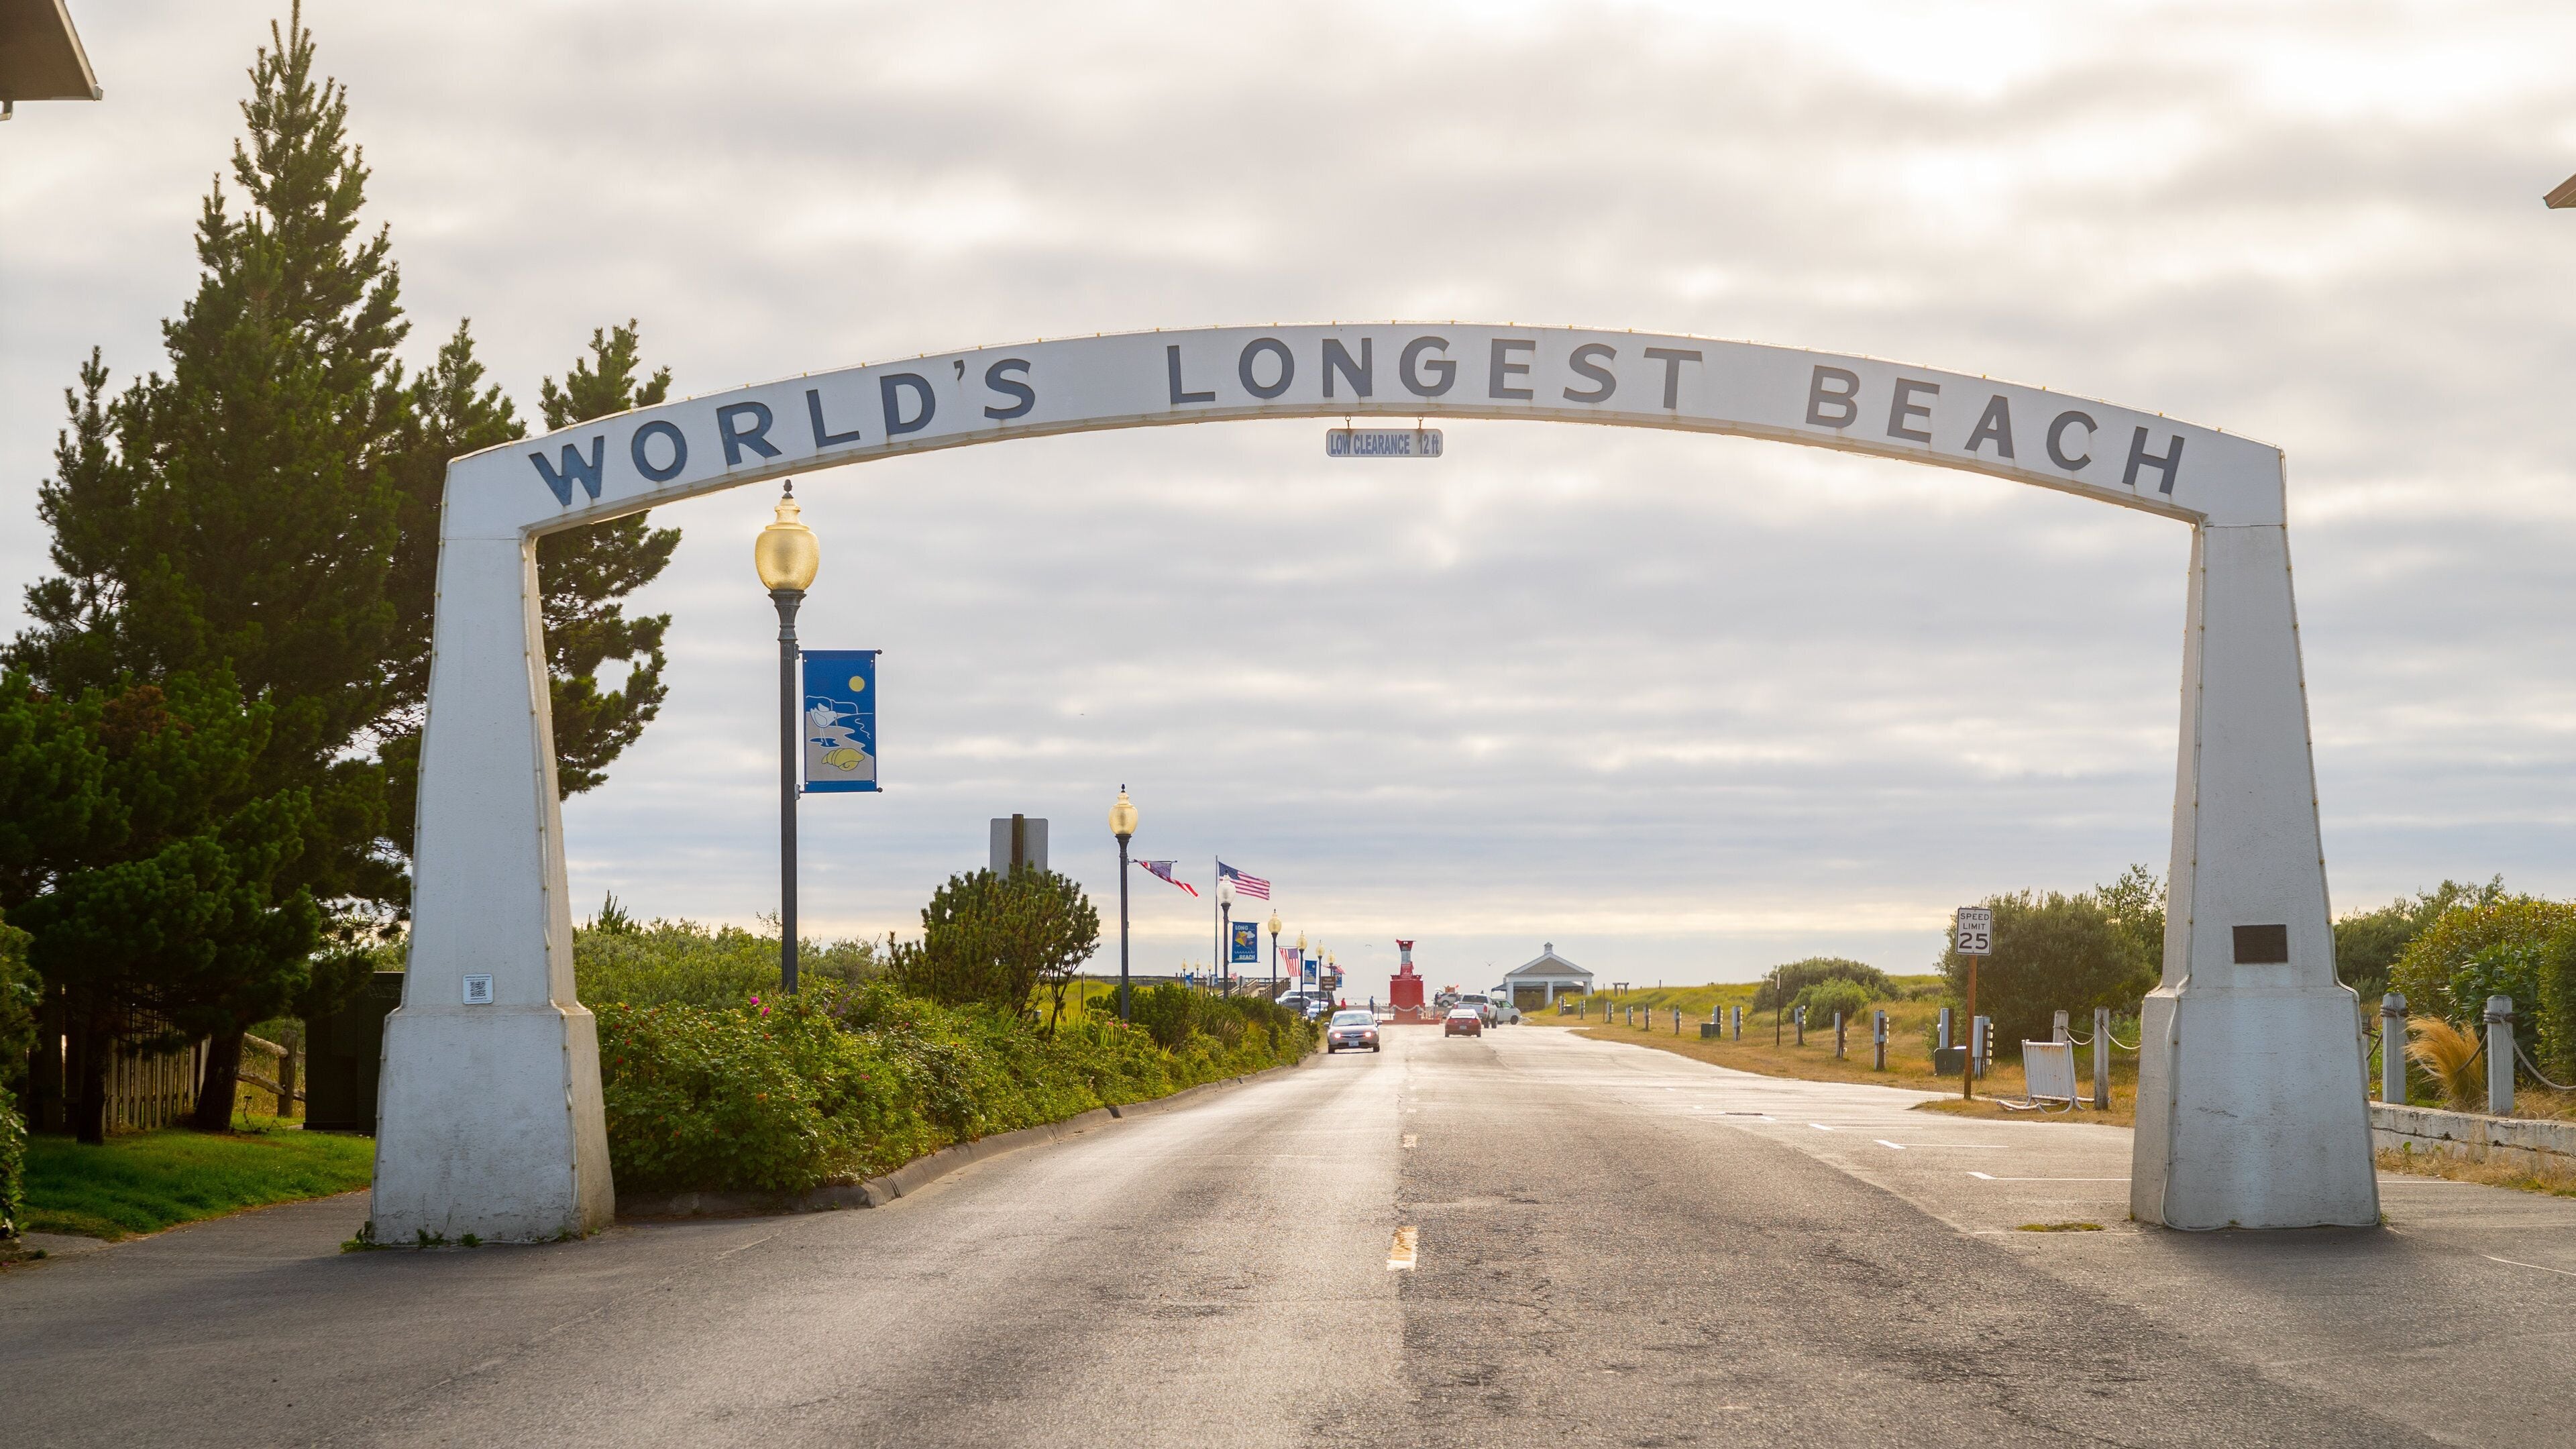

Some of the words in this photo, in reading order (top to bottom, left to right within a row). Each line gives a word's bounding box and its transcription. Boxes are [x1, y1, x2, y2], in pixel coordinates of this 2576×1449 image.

[528, 358, 1036, 507] WORLD'S
[1167, 335, 1703, 410] LONGEST
[1805, 364, 2186, 495] BEACH
[1330, 434, 1351, 455] LOW
[1354, 434, 1410, 455] CLEARANCE
[1418, 434, 1430, 455] 12
[1432, 434, 1439, 455] ft
[1959, 932, 1988, 950] 25
